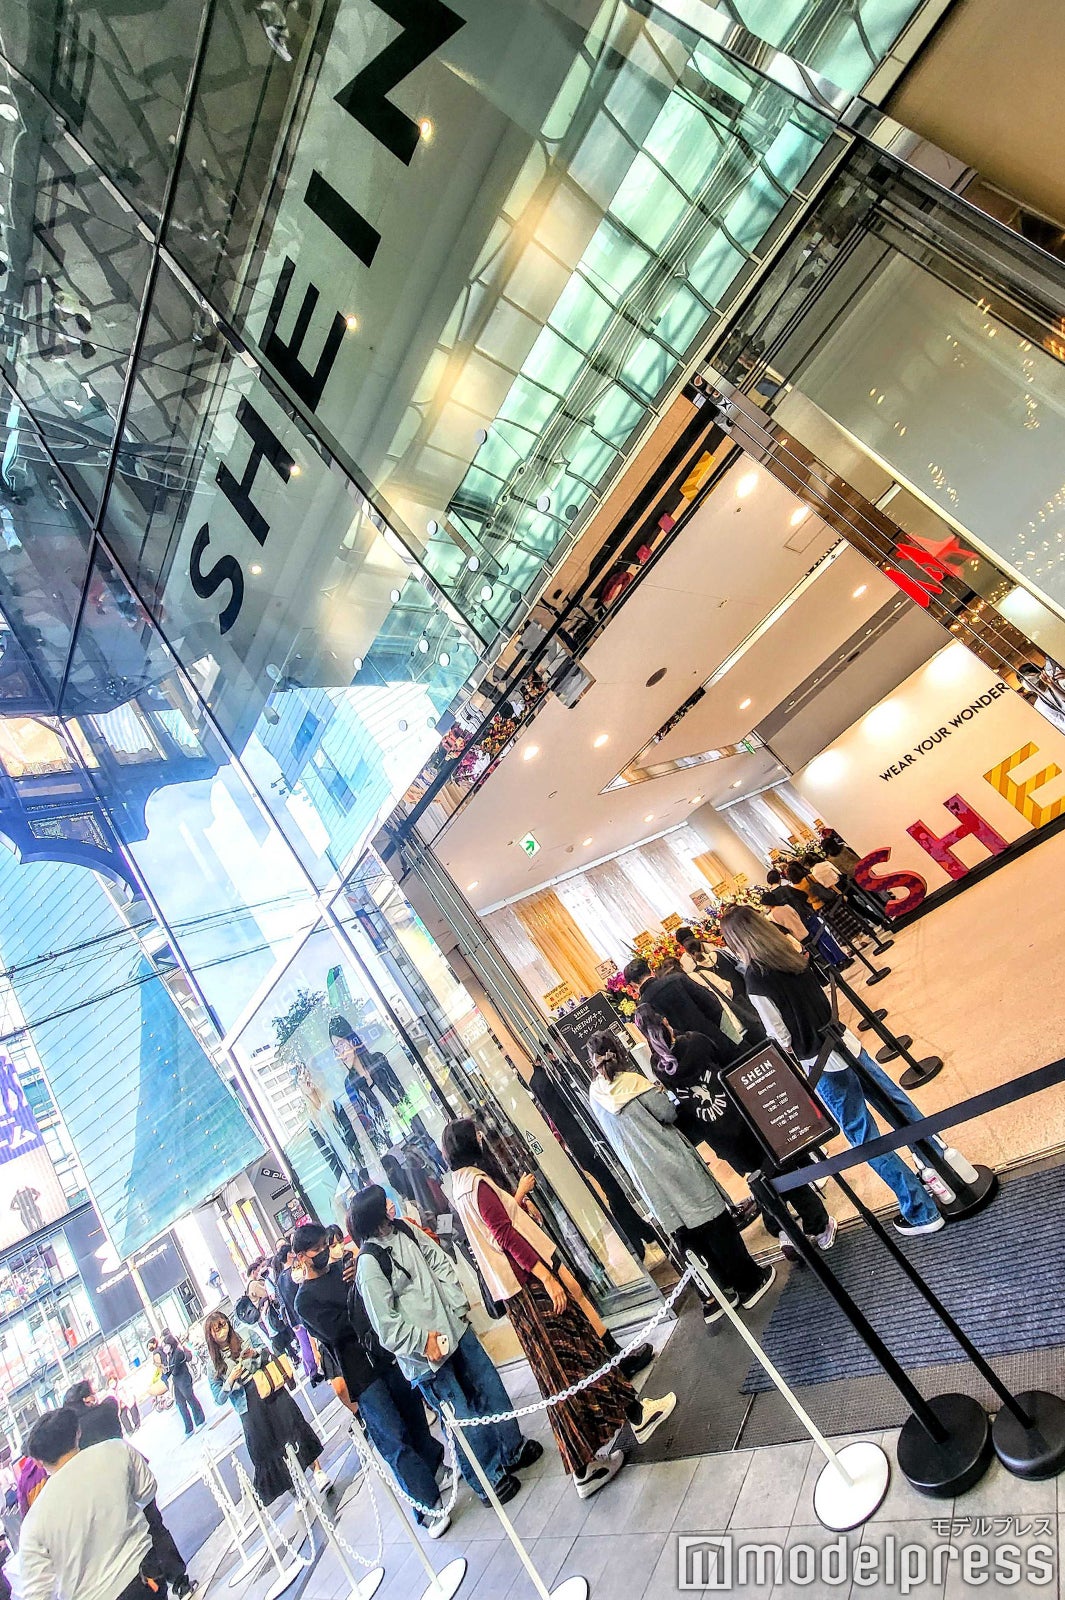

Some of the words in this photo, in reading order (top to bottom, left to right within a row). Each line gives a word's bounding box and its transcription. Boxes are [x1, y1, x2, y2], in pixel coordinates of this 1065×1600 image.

[190, 0, 467, 635] SHEIN
[879, 754, 916, 782] WEAR
[914, 727, 951, 756] YOUR
[948, 682, 1010, 728] WONDER
[741, 1060, 773, 1086] SHEIN
